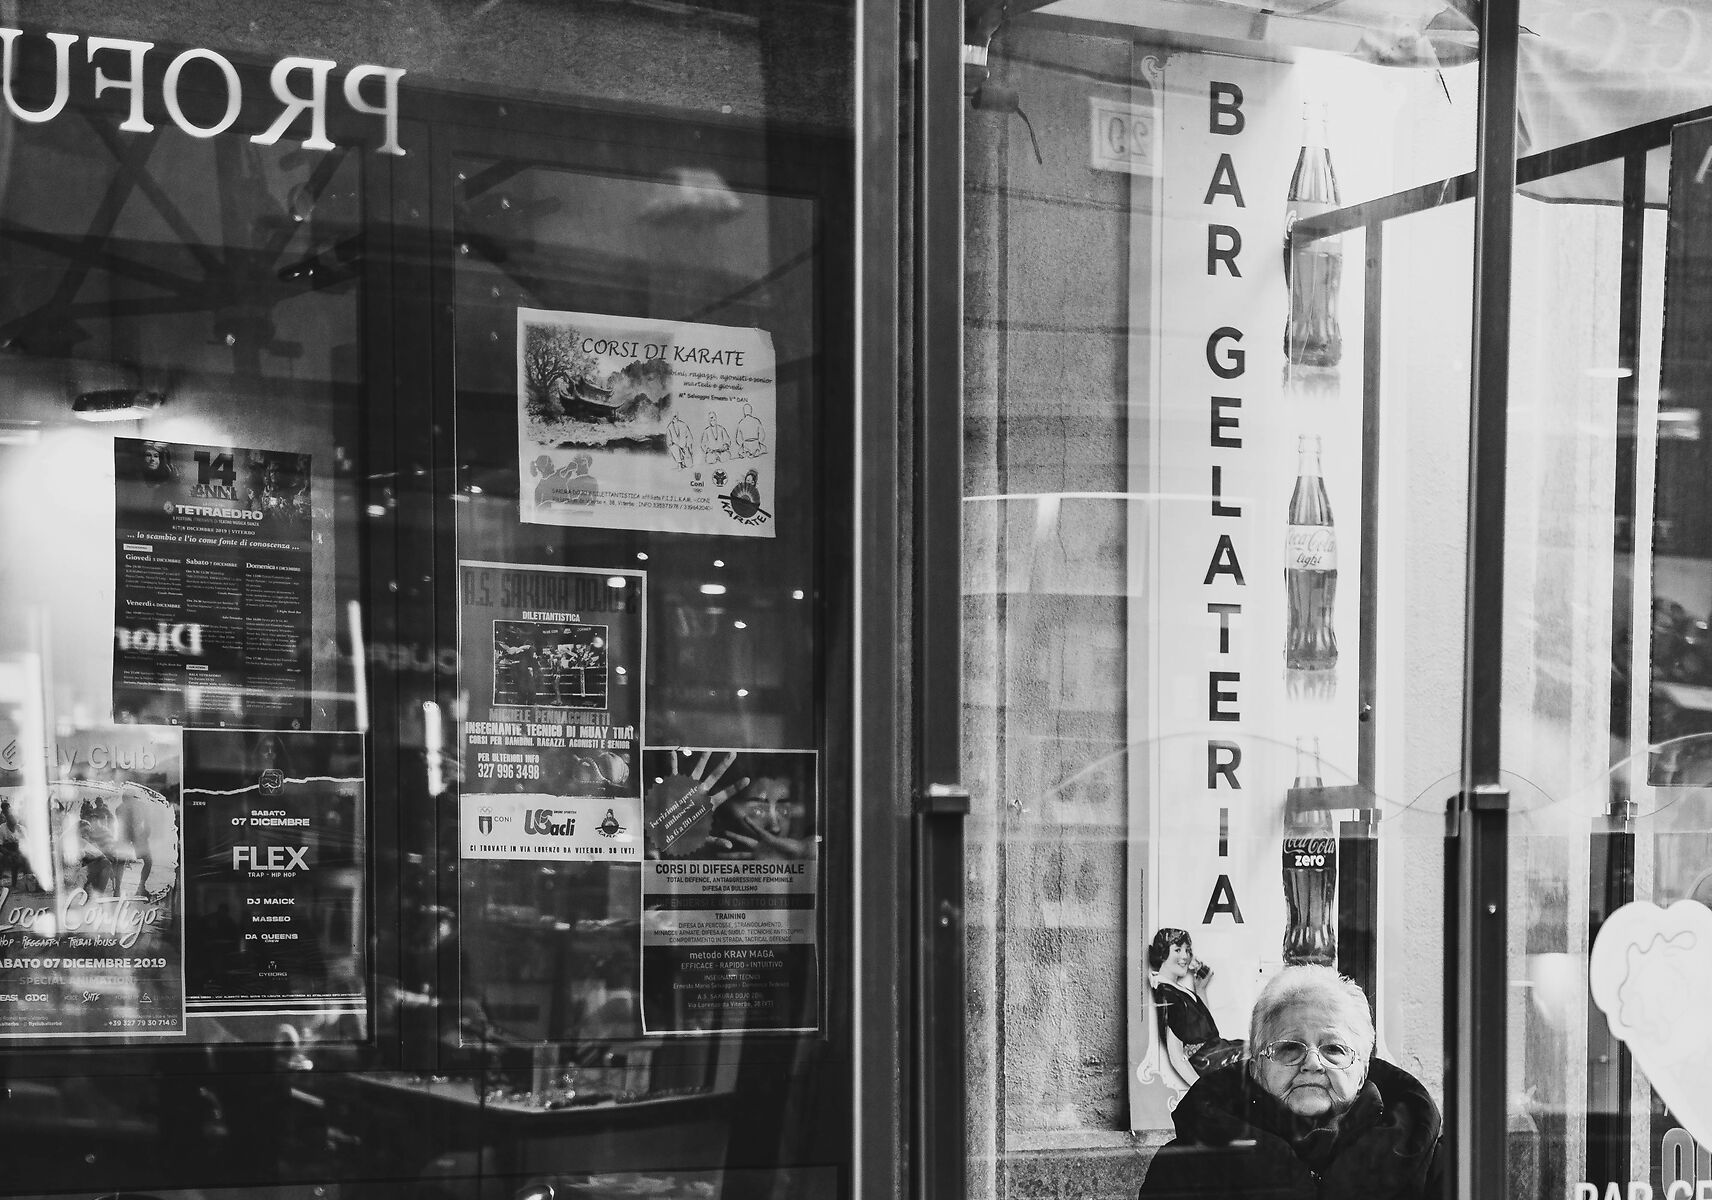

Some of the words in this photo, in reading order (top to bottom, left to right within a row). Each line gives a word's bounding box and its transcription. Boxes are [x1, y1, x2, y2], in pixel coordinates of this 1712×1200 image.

[1203, 80, 1246, 279] BAR
[581, 337, 639, 358] CORSI
[644, 343, 667, 360] DI
[673, 345, 746, 367] KARATE
[193, 450, 237, 486] 14
[175, 504, 264, 521] TETRAEDRO
[721, 501, 767, 526] KARATE
[146, 532, 177, 543] scambio
[198, 537, 218, 546] come
[217, 536, 238, 547] fonte
[239, 538, 248, 546] di
[249, 540, 290, 550] conoscenza
[246, 562, 276, 570] Domenica
[1296, 553, 1322, 568] light
[522, 611, 581, 622] DILETTANTISTICA
[1202, 326, 1247, 925] GELATERIA
[465, 721, 522, 736] INSEGNANTE
[526, 723, 563, 737] TECNICO
[566, 725, 576, 738] DI
[579, 726, 608, 739] MUAY
[469, 735, 488, 745] CORSI
[489, 736, 502, 746] PER
[569, 738, 599, 749] AGONISTI
[601, 739, 606, 749] E
[607, 740, 630, 750] SENIOR
[87, 744, 156, 770] Club
[478, 752, 490, 762] PER
[492, 753, 523, 763] ULTERIORI
[525, 753, 540, 763] INFO
[478, 763, 493, 778] 327
[497, 764, 513, 779] 996
[516, 764, 540, 779] 3498
[231, 818, 247, 826] 07
[250, 818, 310, 826] DICEMBRE
[665, 835, 675, 844] da
[691, 804, 707, 821] anni
[470, 844, 477, 852] CI
[480, 845, 507, 853] TROVATE
[510, 845, 517, 853] IN
[520, 845, 531, 853] VIA
[534, 846, 560, 854] LORENZO
[563, 846, 572, 854] DA
[232, 846, 310, 871] FLEX
[1295, 855, 1325, 867] zero
[655, 863, 686, 875] CORSI
[690, 864, 700, 875] DI
[702, 864, 739, 875] DIFESA
[742, 864, 804, 875] PERSONALE
[64, 887, 161, 949] Contigo
[715, 912, 746, 920] TRAINING
[261, 933, 298, 941] QUEENS
[689, 951, 722, 959] metodo
[724, 950, 748, 959] KRAV
[749, 950, 774, 958] MAGA
[43, 958, 61, 968] 07
[63, 958, 131, 968] DICEMBRE
[134, 958, 166, 968] 2019
[19, 976, 65, 985] SPECIAL
[69, 976, 133, 985] ANIMATION
